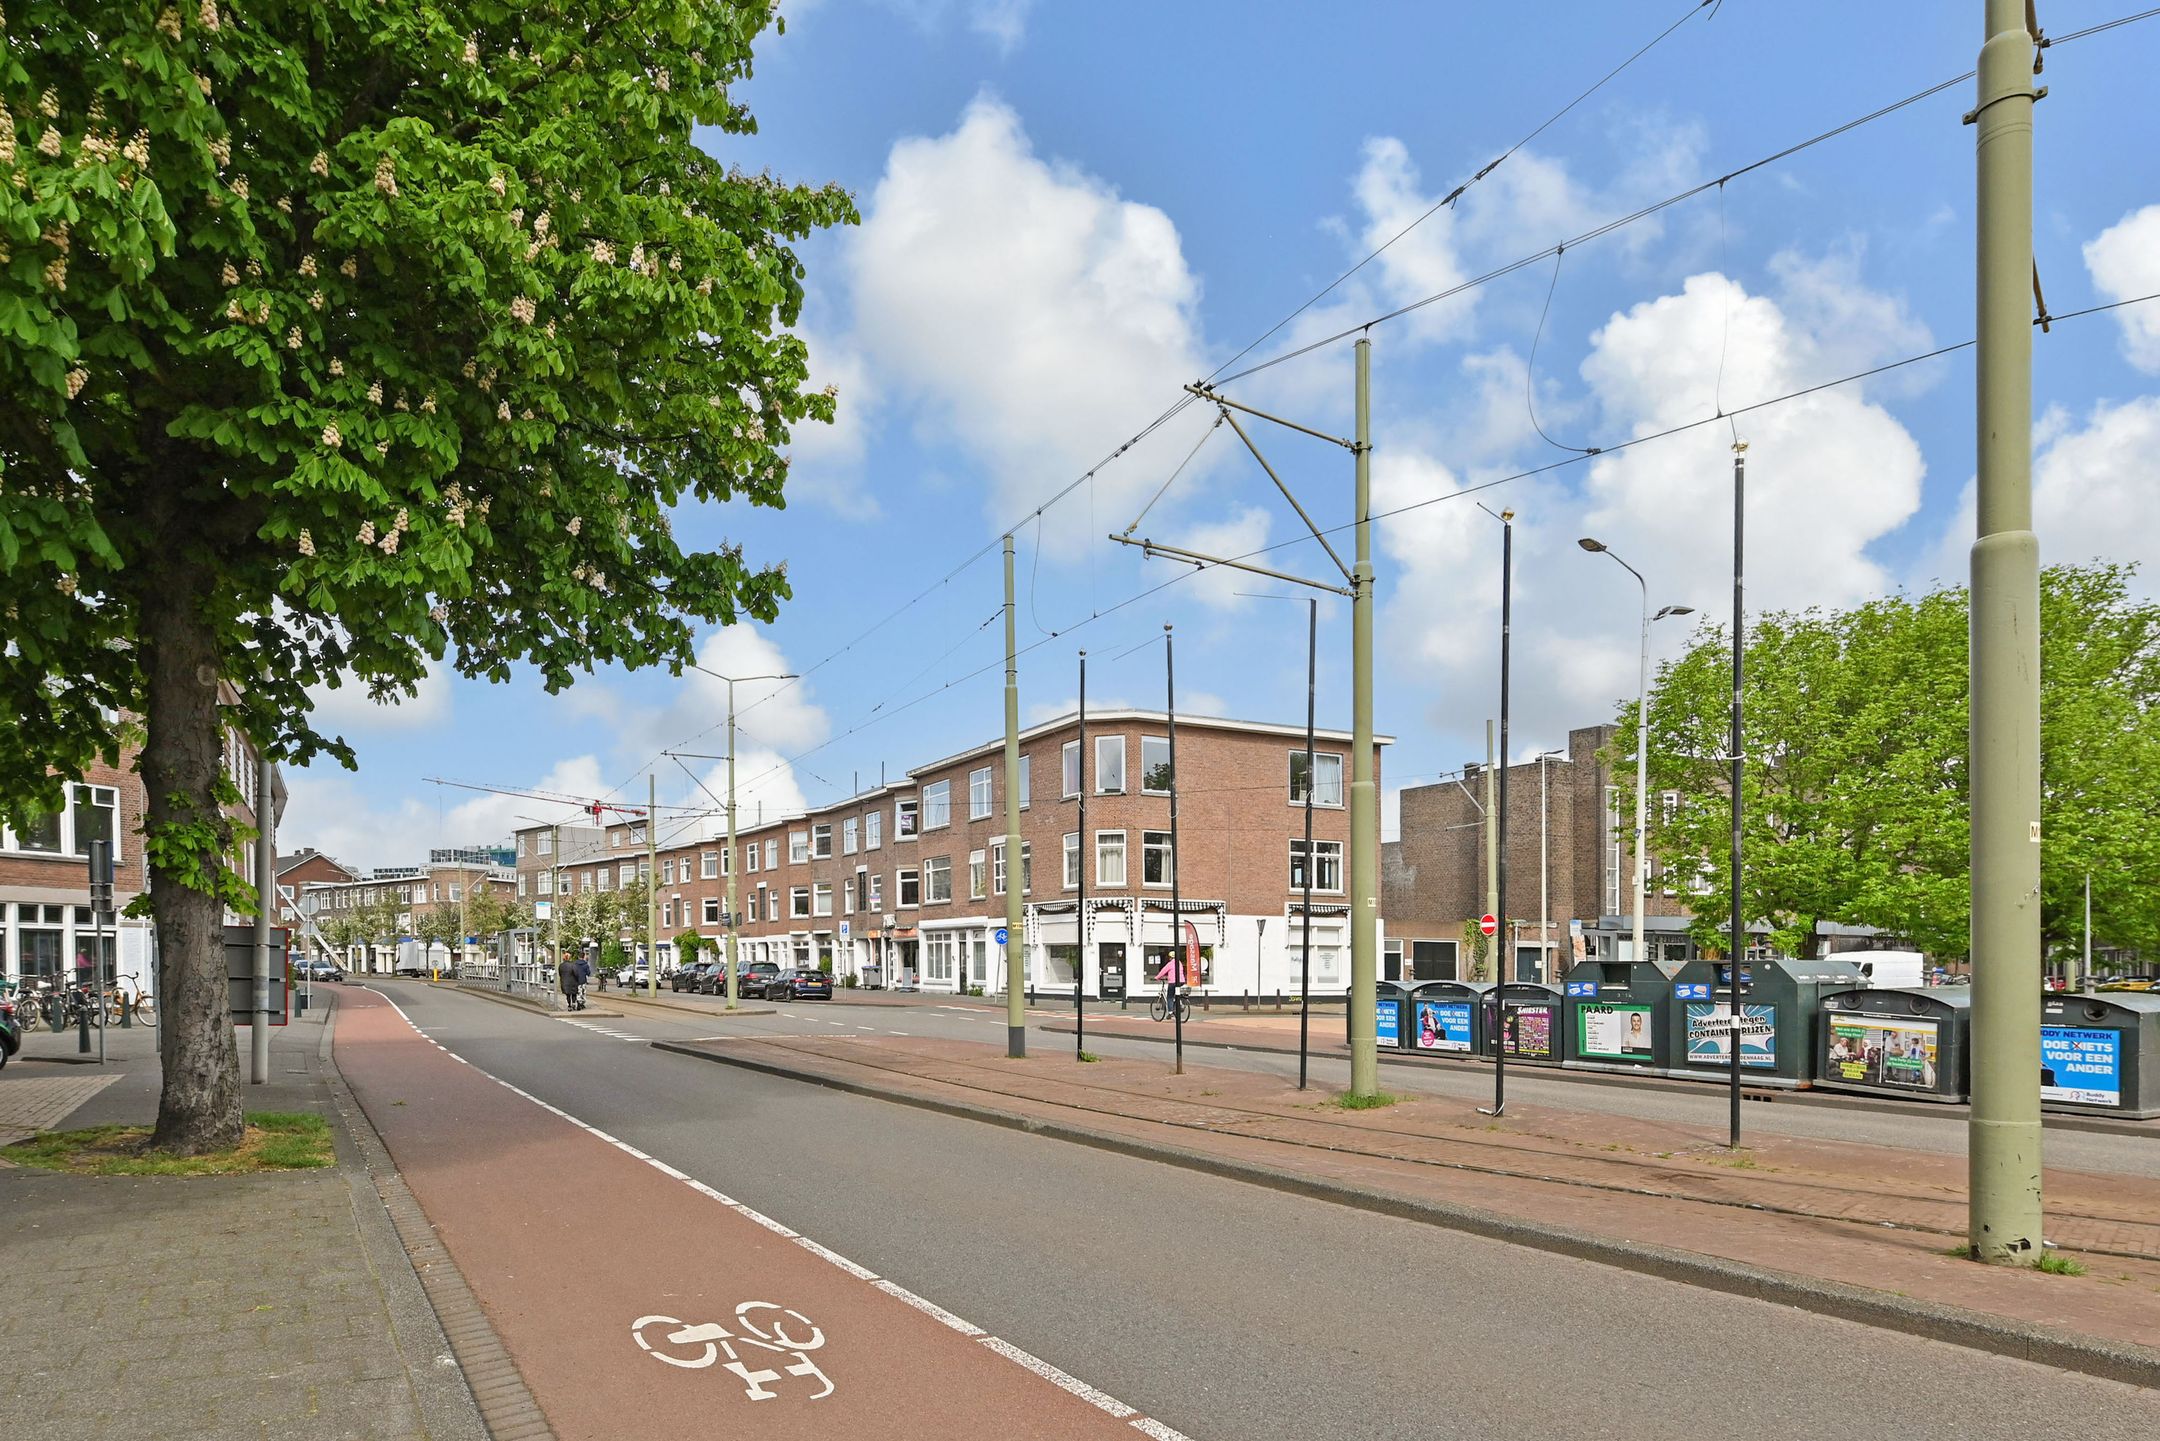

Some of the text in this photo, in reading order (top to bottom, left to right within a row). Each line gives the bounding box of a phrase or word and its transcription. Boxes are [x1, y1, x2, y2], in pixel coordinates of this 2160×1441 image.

[1580, 1005, 1614, 1014] PAARD
[2063, 1031, 2113, 1040] NETWERK
[2043, 1039, 2069, 1050] DOE
[2046, 1050, 2113, 1064] VOOR EEN
[2065, 1063, 2113, 1075] ANDER
